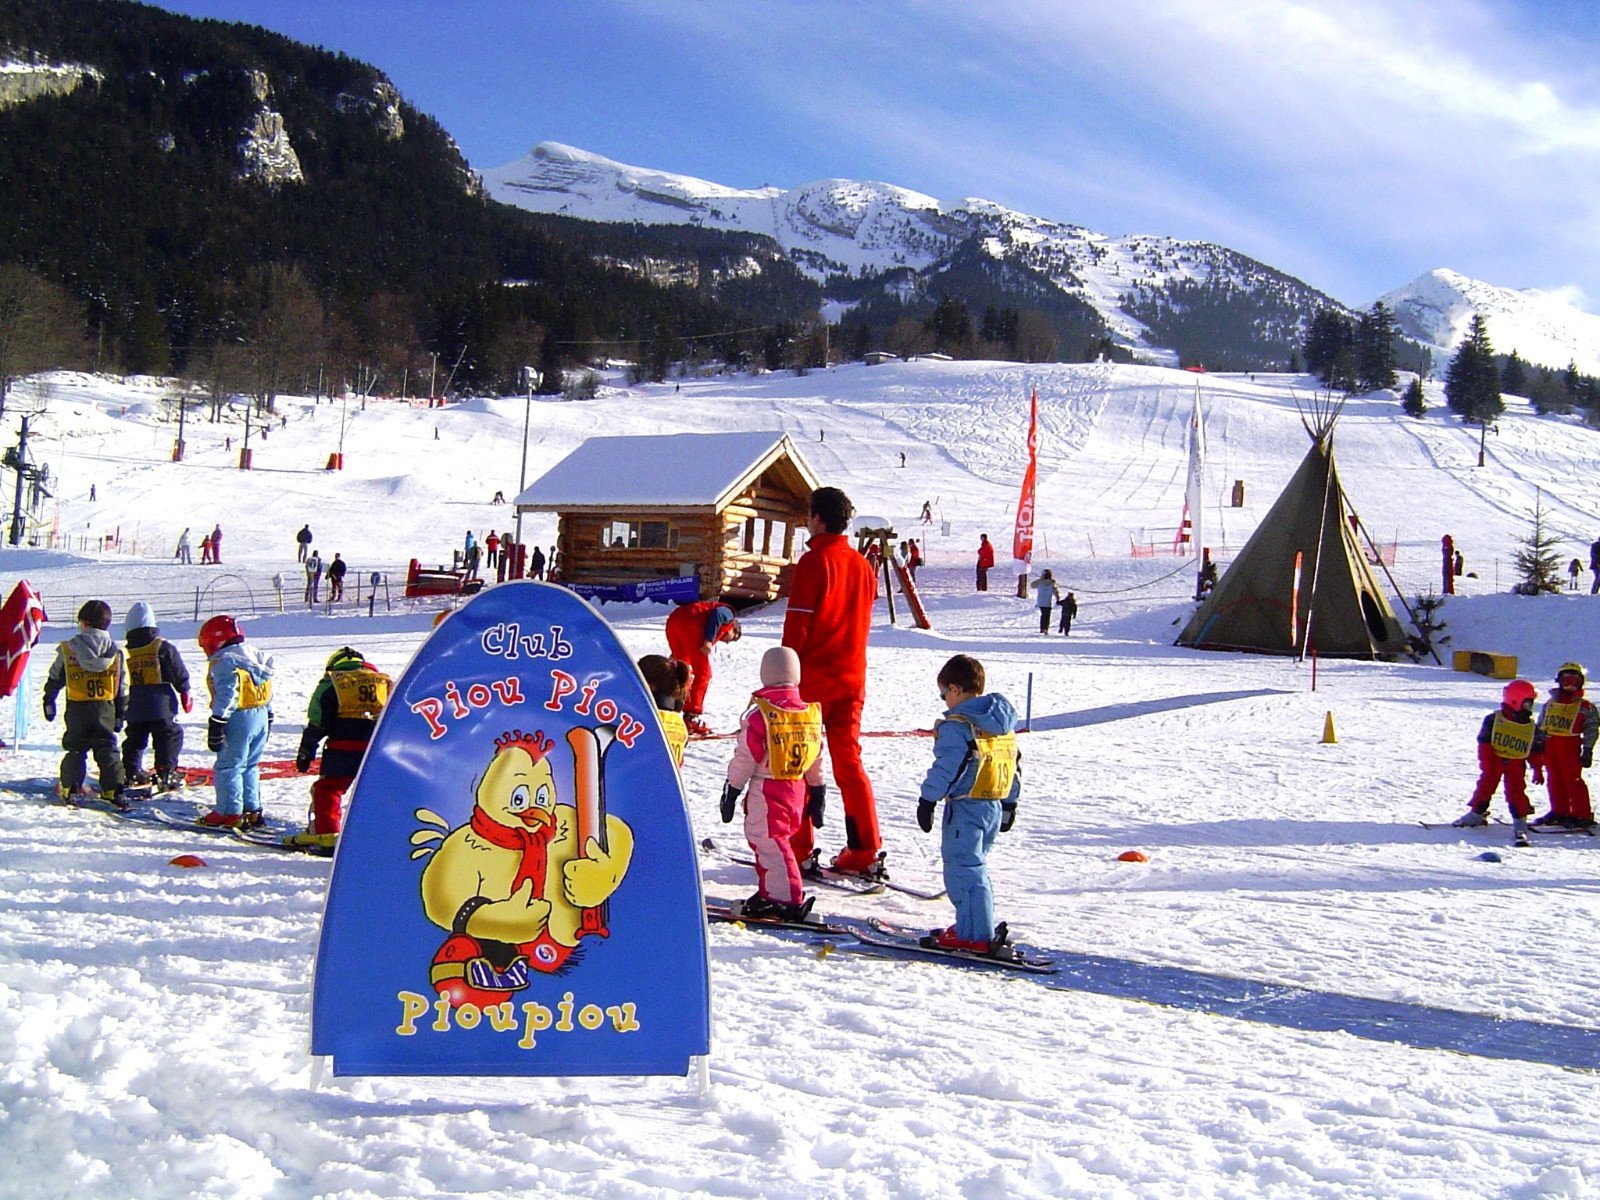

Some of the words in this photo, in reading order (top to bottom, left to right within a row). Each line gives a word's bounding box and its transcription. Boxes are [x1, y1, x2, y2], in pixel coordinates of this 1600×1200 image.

[482, 623, 573, 661] Club
[412, 677, 525, 739] Piou
[544, 669, 645, 748] Piou
[791, 743, 808, 770] 97
[1493, 732, 1529, 754] FLOCON
[396, 991, 640, 1049] Pioupiou
